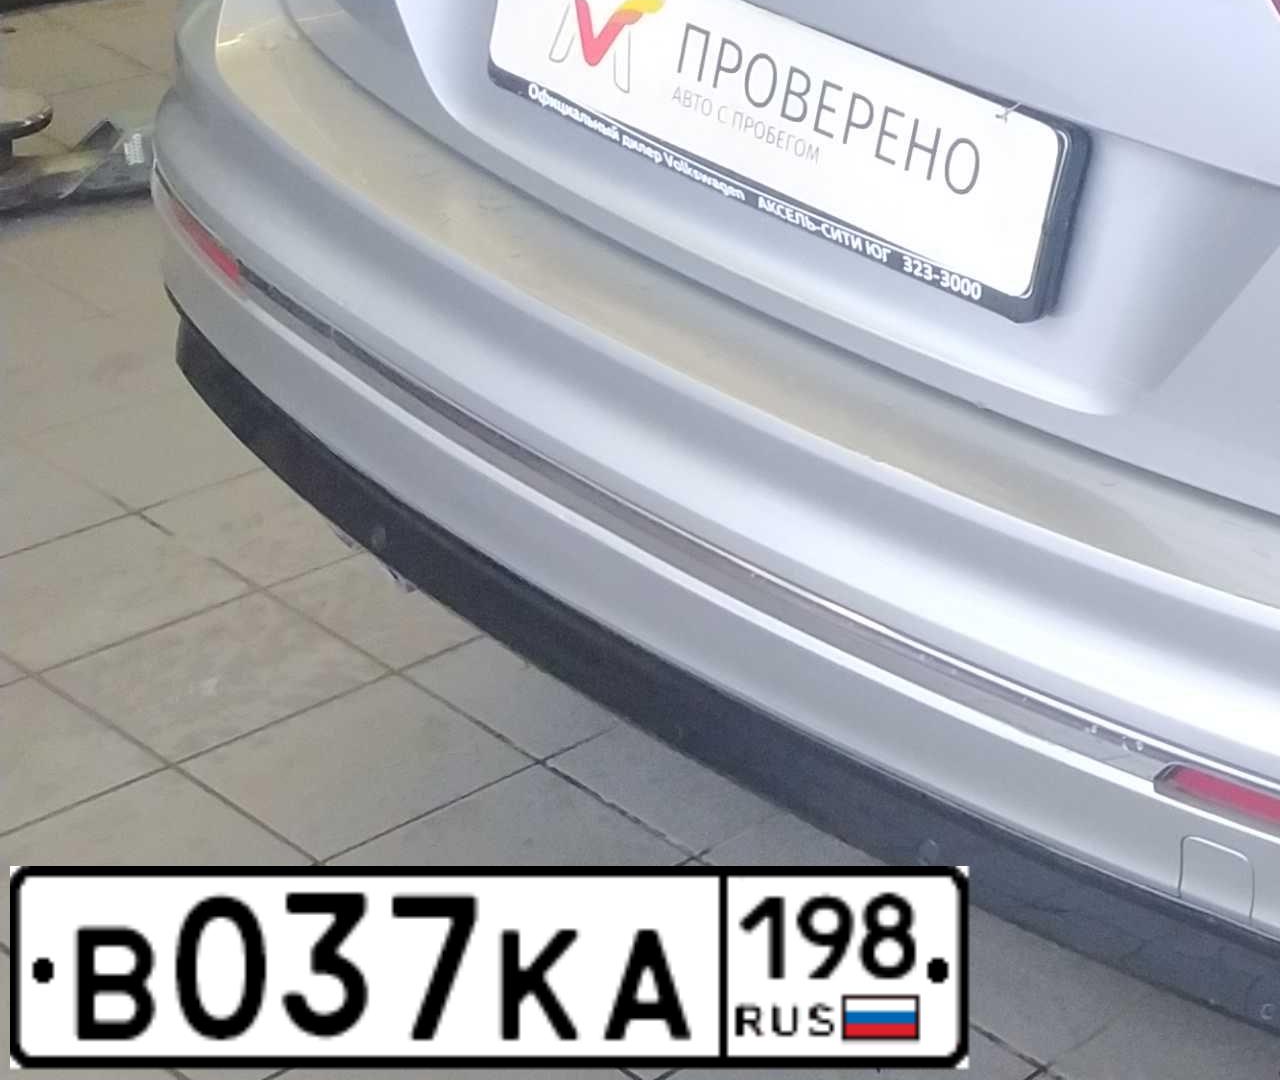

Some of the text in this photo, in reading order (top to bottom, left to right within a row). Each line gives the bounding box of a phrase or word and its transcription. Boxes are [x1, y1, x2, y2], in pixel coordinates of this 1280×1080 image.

[527, 83, 621, 142] Официальный
[663, 151, 747, 201] Volkswagen
[757, 195, 863, 253] АКСЕЛЬ-СИТИ
[864, 239, 892, 263] ЮГ
[902, 254, 983, 301] 323-3000
[671, 85, 821, 165] АВТО С ПРОБЕГОМ
[676, 22, 981, 195] ПРОВЕРЕНО
